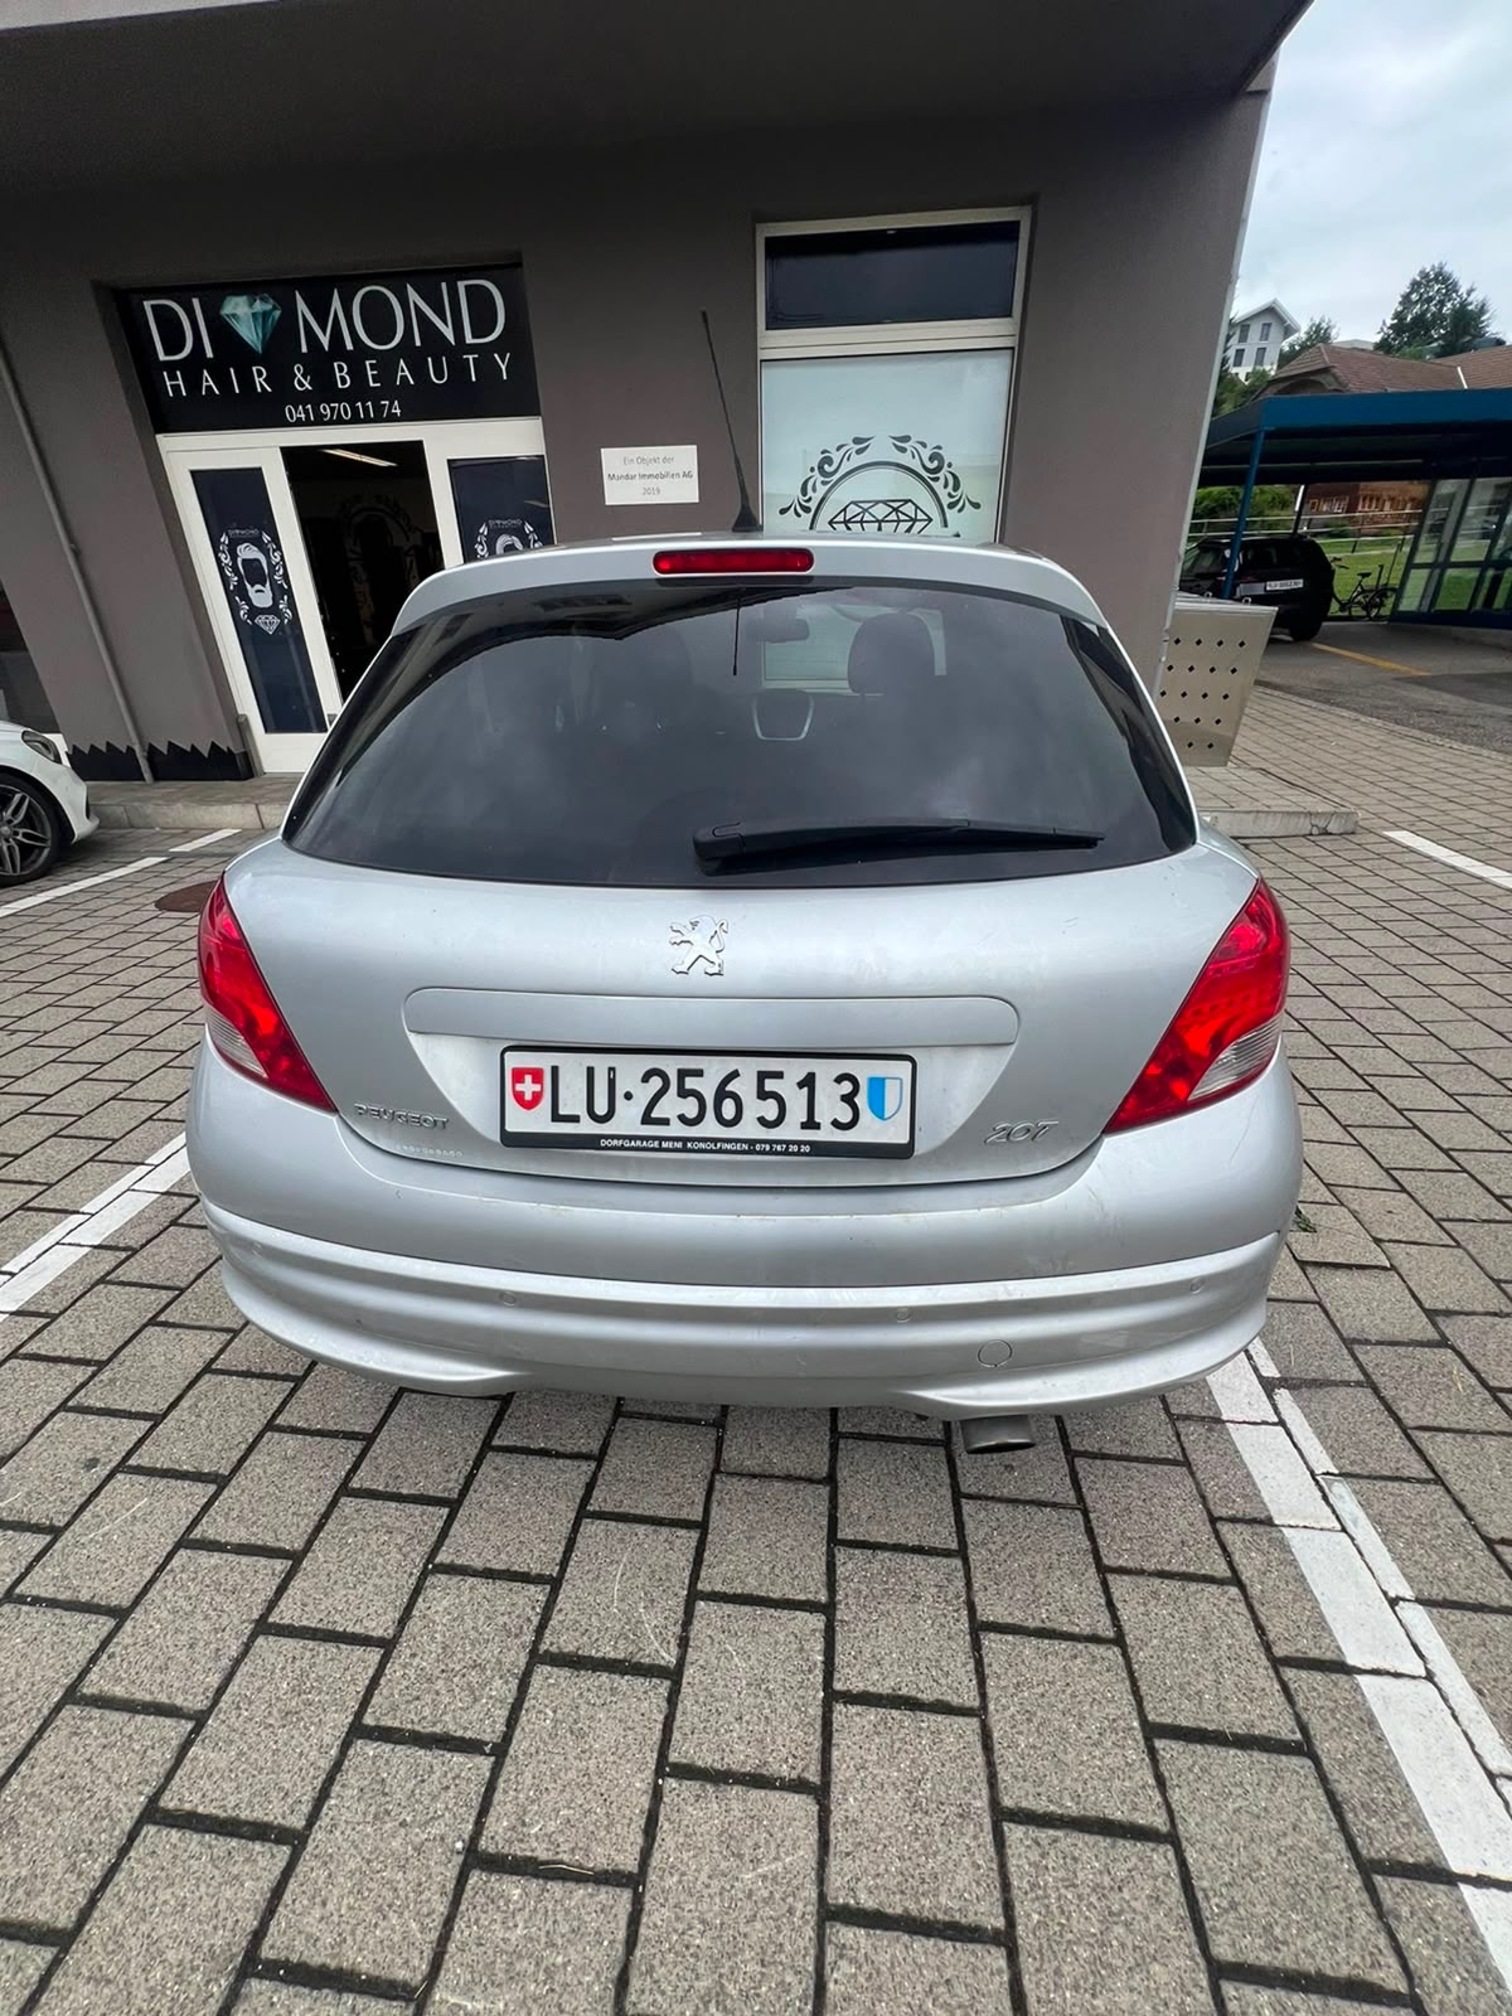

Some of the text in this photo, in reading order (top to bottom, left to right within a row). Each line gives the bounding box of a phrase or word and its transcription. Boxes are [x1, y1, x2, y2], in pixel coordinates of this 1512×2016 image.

[163, 352, 511, 398] HAIR & BEAUTY
[284, 400, 402, 423] 041 970 11 74
[623, 456, 675, 467] Ein Objekt der
[638, 470, 681, 480] Immobilien
[682, 470, 694, 479] AG
[642, 487, 661, 496] 2019
[354, 1103, 450, 1130] PEUGEOT
[984, 1120, 1060, 1145] 207
[600, 1139, 660, 1149] DORFGARAGE
[686, 1141, 749, 1151] KONOLFINGEN
[755, 1143, 771, 1152] 079
[788, 1144, 799, 1152] 20
[800, 1144, 811, 1153] 20
